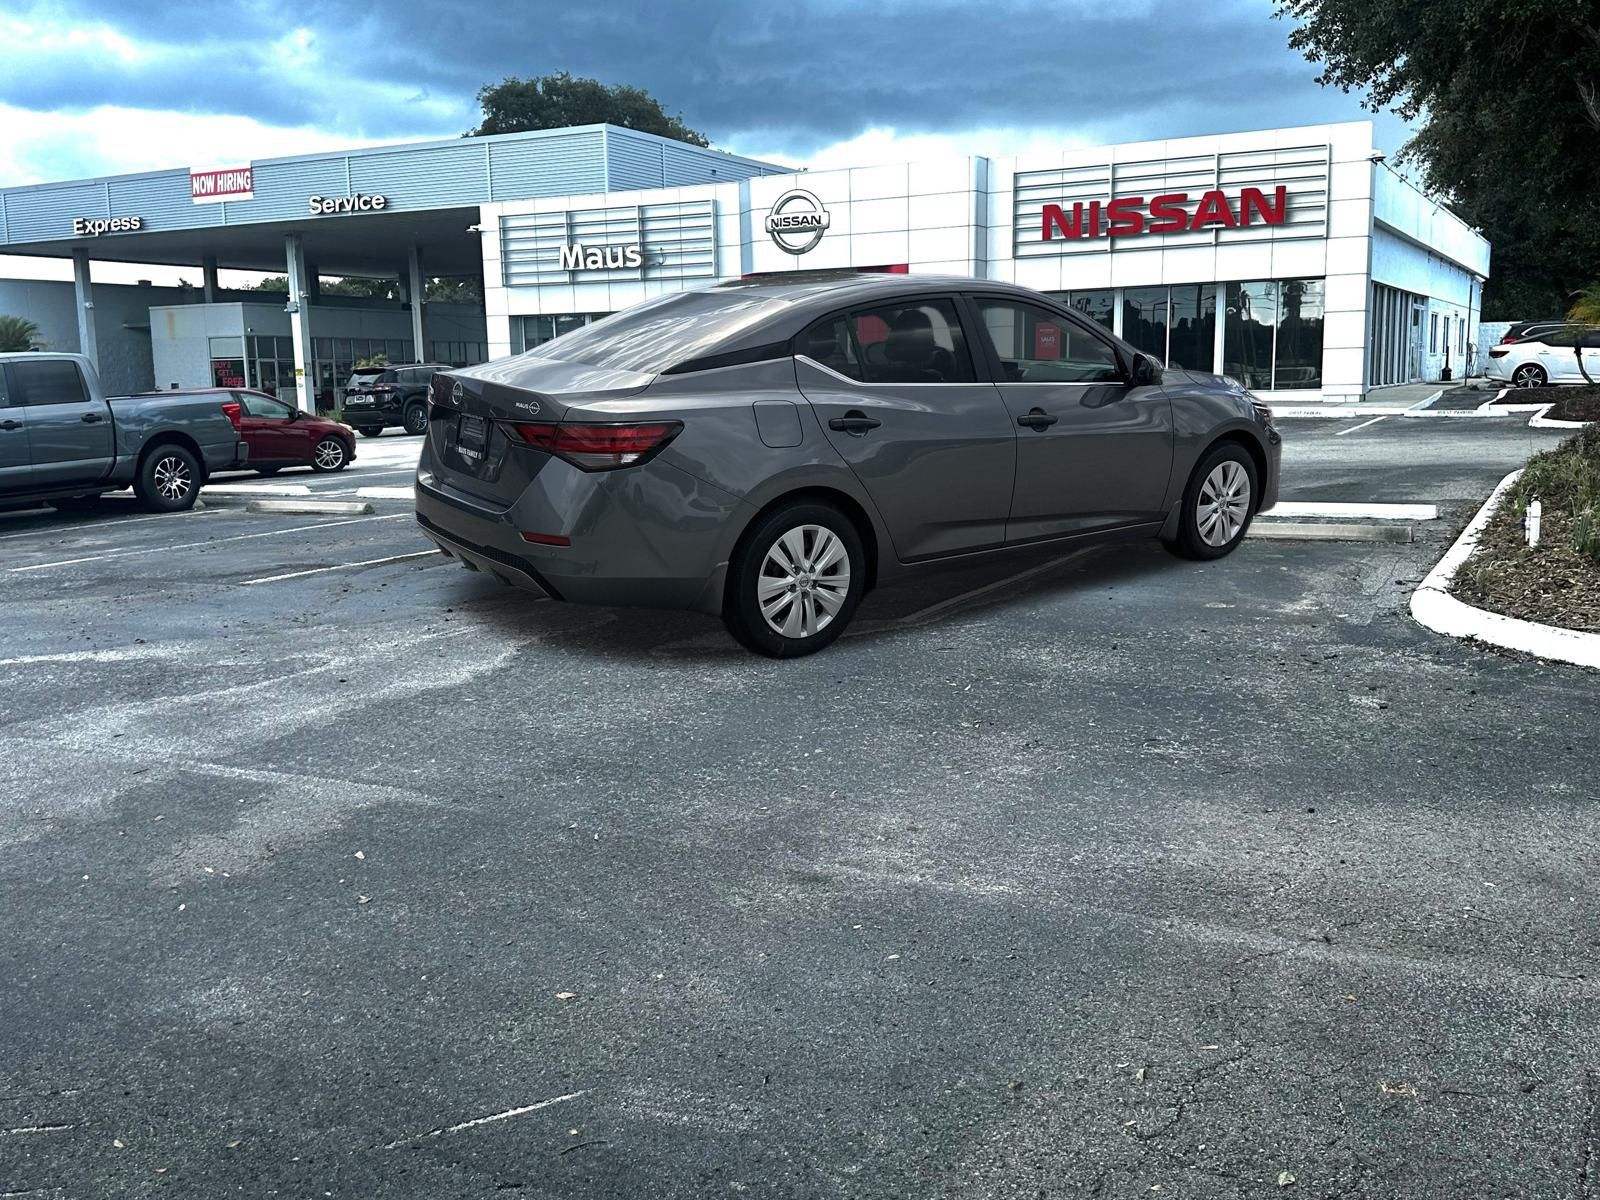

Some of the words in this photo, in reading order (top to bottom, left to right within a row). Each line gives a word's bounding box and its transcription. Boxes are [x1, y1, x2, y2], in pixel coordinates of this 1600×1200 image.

[192, 174, 215, 195] NOW
[217, 170, 251, 193] HIRING
[73, 216, 141, 237] Express
[309, 192, 385, 215] Service
[770, 215, 822, 228] NISSAN
[1042, 185, 1287, 241] NISSAN
[559, 243, 642, 271] Maus
[214, 361, 226, 369] BUY
[223, 377, 244, 387] FREE
[515, 401, 529, 410] MAUS
